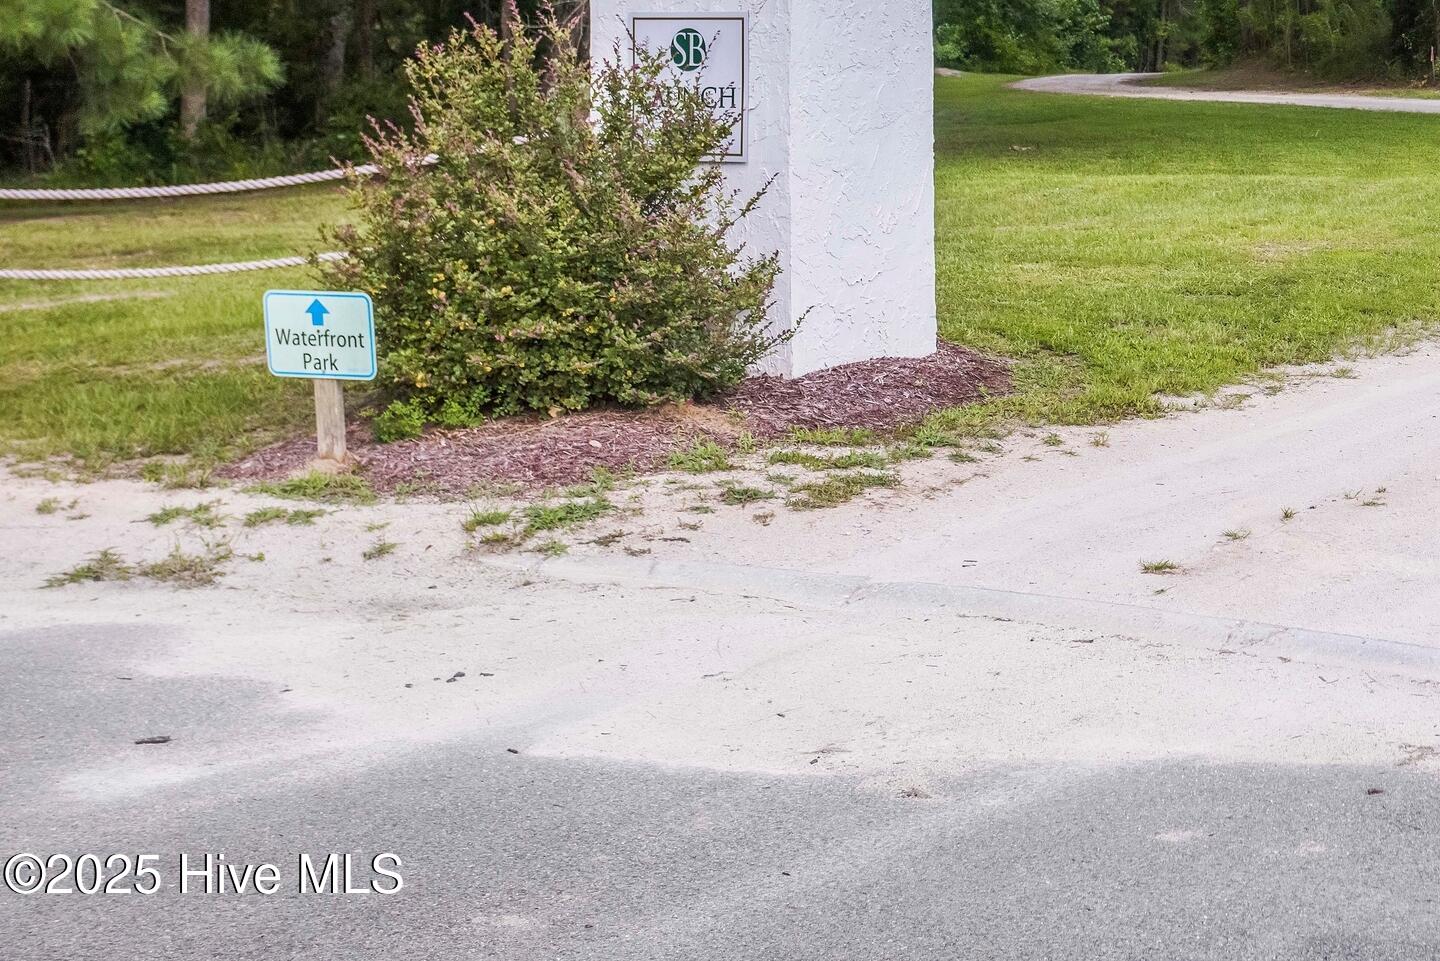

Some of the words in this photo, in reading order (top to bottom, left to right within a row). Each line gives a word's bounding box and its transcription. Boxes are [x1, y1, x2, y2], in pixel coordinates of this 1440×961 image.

[672, 32, 706, 67] SB
[275, 328, 365, 349] Waterfront
[303, 352, 339, 371] Park
